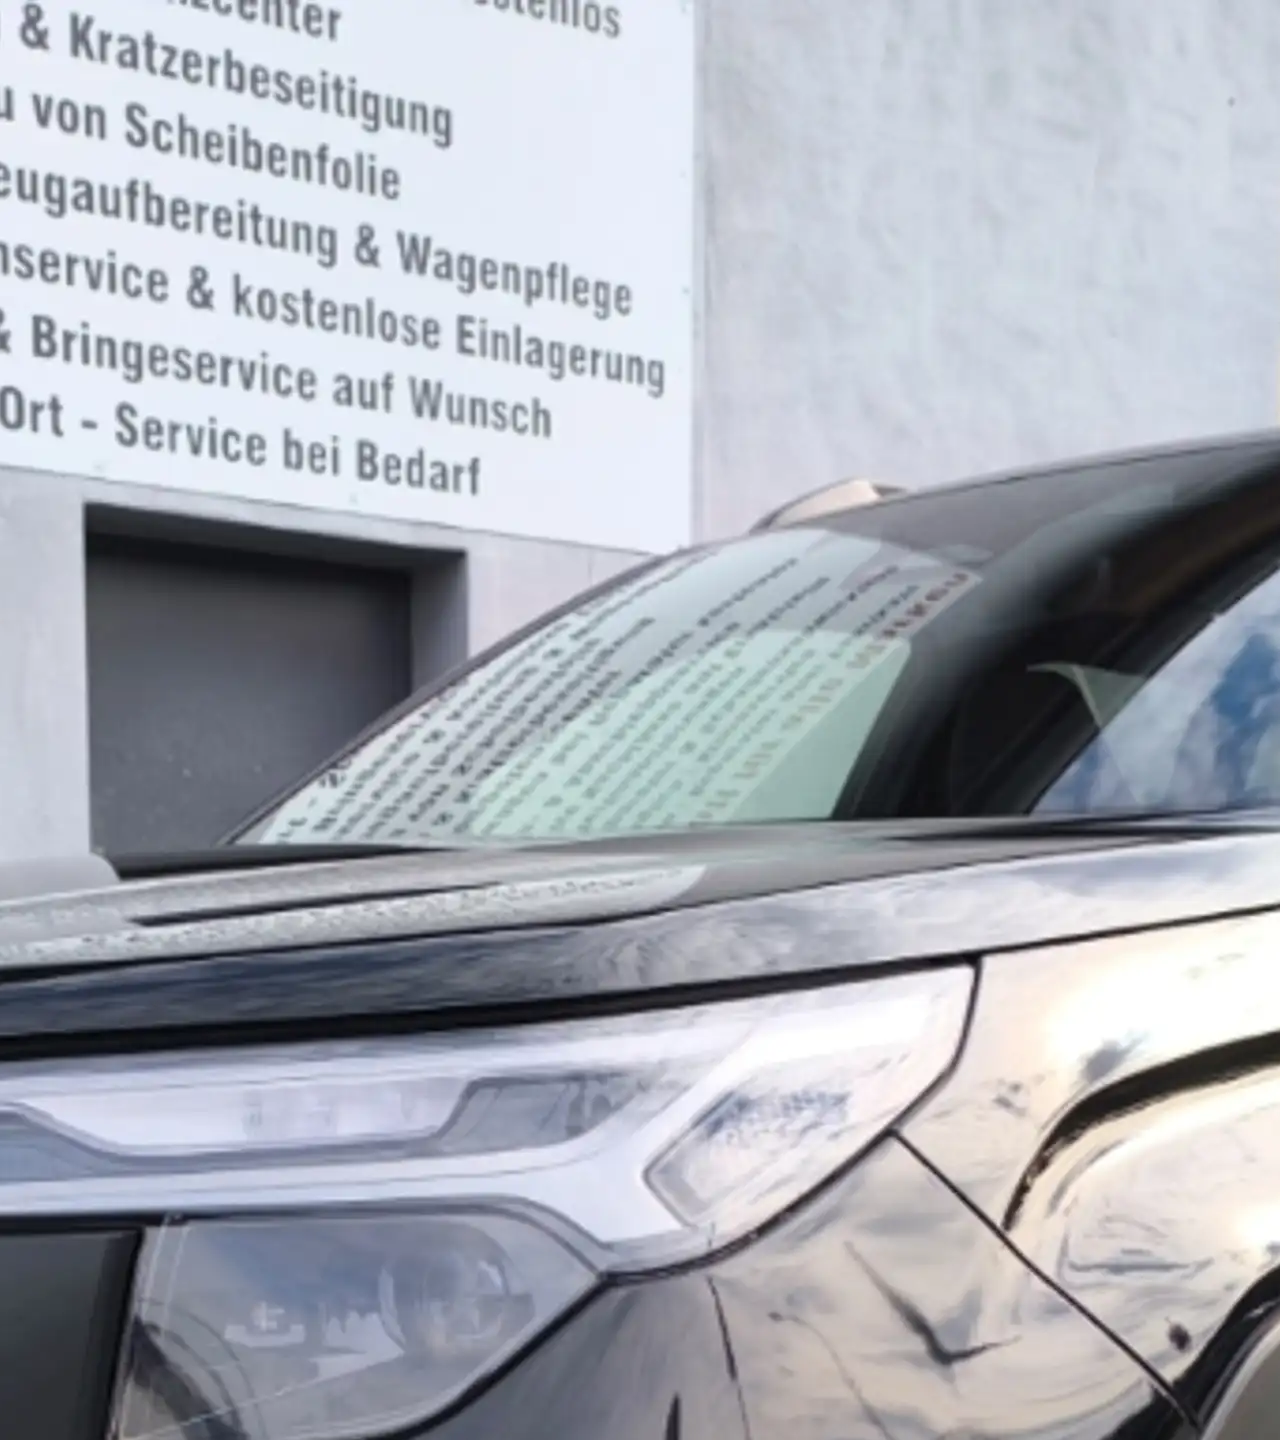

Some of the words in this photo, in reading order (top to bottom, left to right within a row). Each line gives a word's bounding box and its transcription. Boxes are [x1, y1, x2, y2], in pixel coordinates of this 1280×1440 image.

[19, 2, 51, 52] &
[69, 12, 454, 149] Kratzerbeseitigung
[31, 92, 107, 140] von
[125, 102, 401, 200] Scheibenfolie
[354, 223, 381, 268] &
[396, 230, 633, 321] Wagenpflege
[32, 314, 318, 402] Bringeservice
[332, 371, 395, 414] auf
[409, 375, 553, 439] Wunsch
[186, 265, 216, 311] &
[234, 272, 442, 350] kostenlose
[456, 314, 666, 399] Einlagerung
[115, 402, 268, 467] Service
[283, 427, 341, 477] bei
[355, 437, 481, 497] Bedarf
